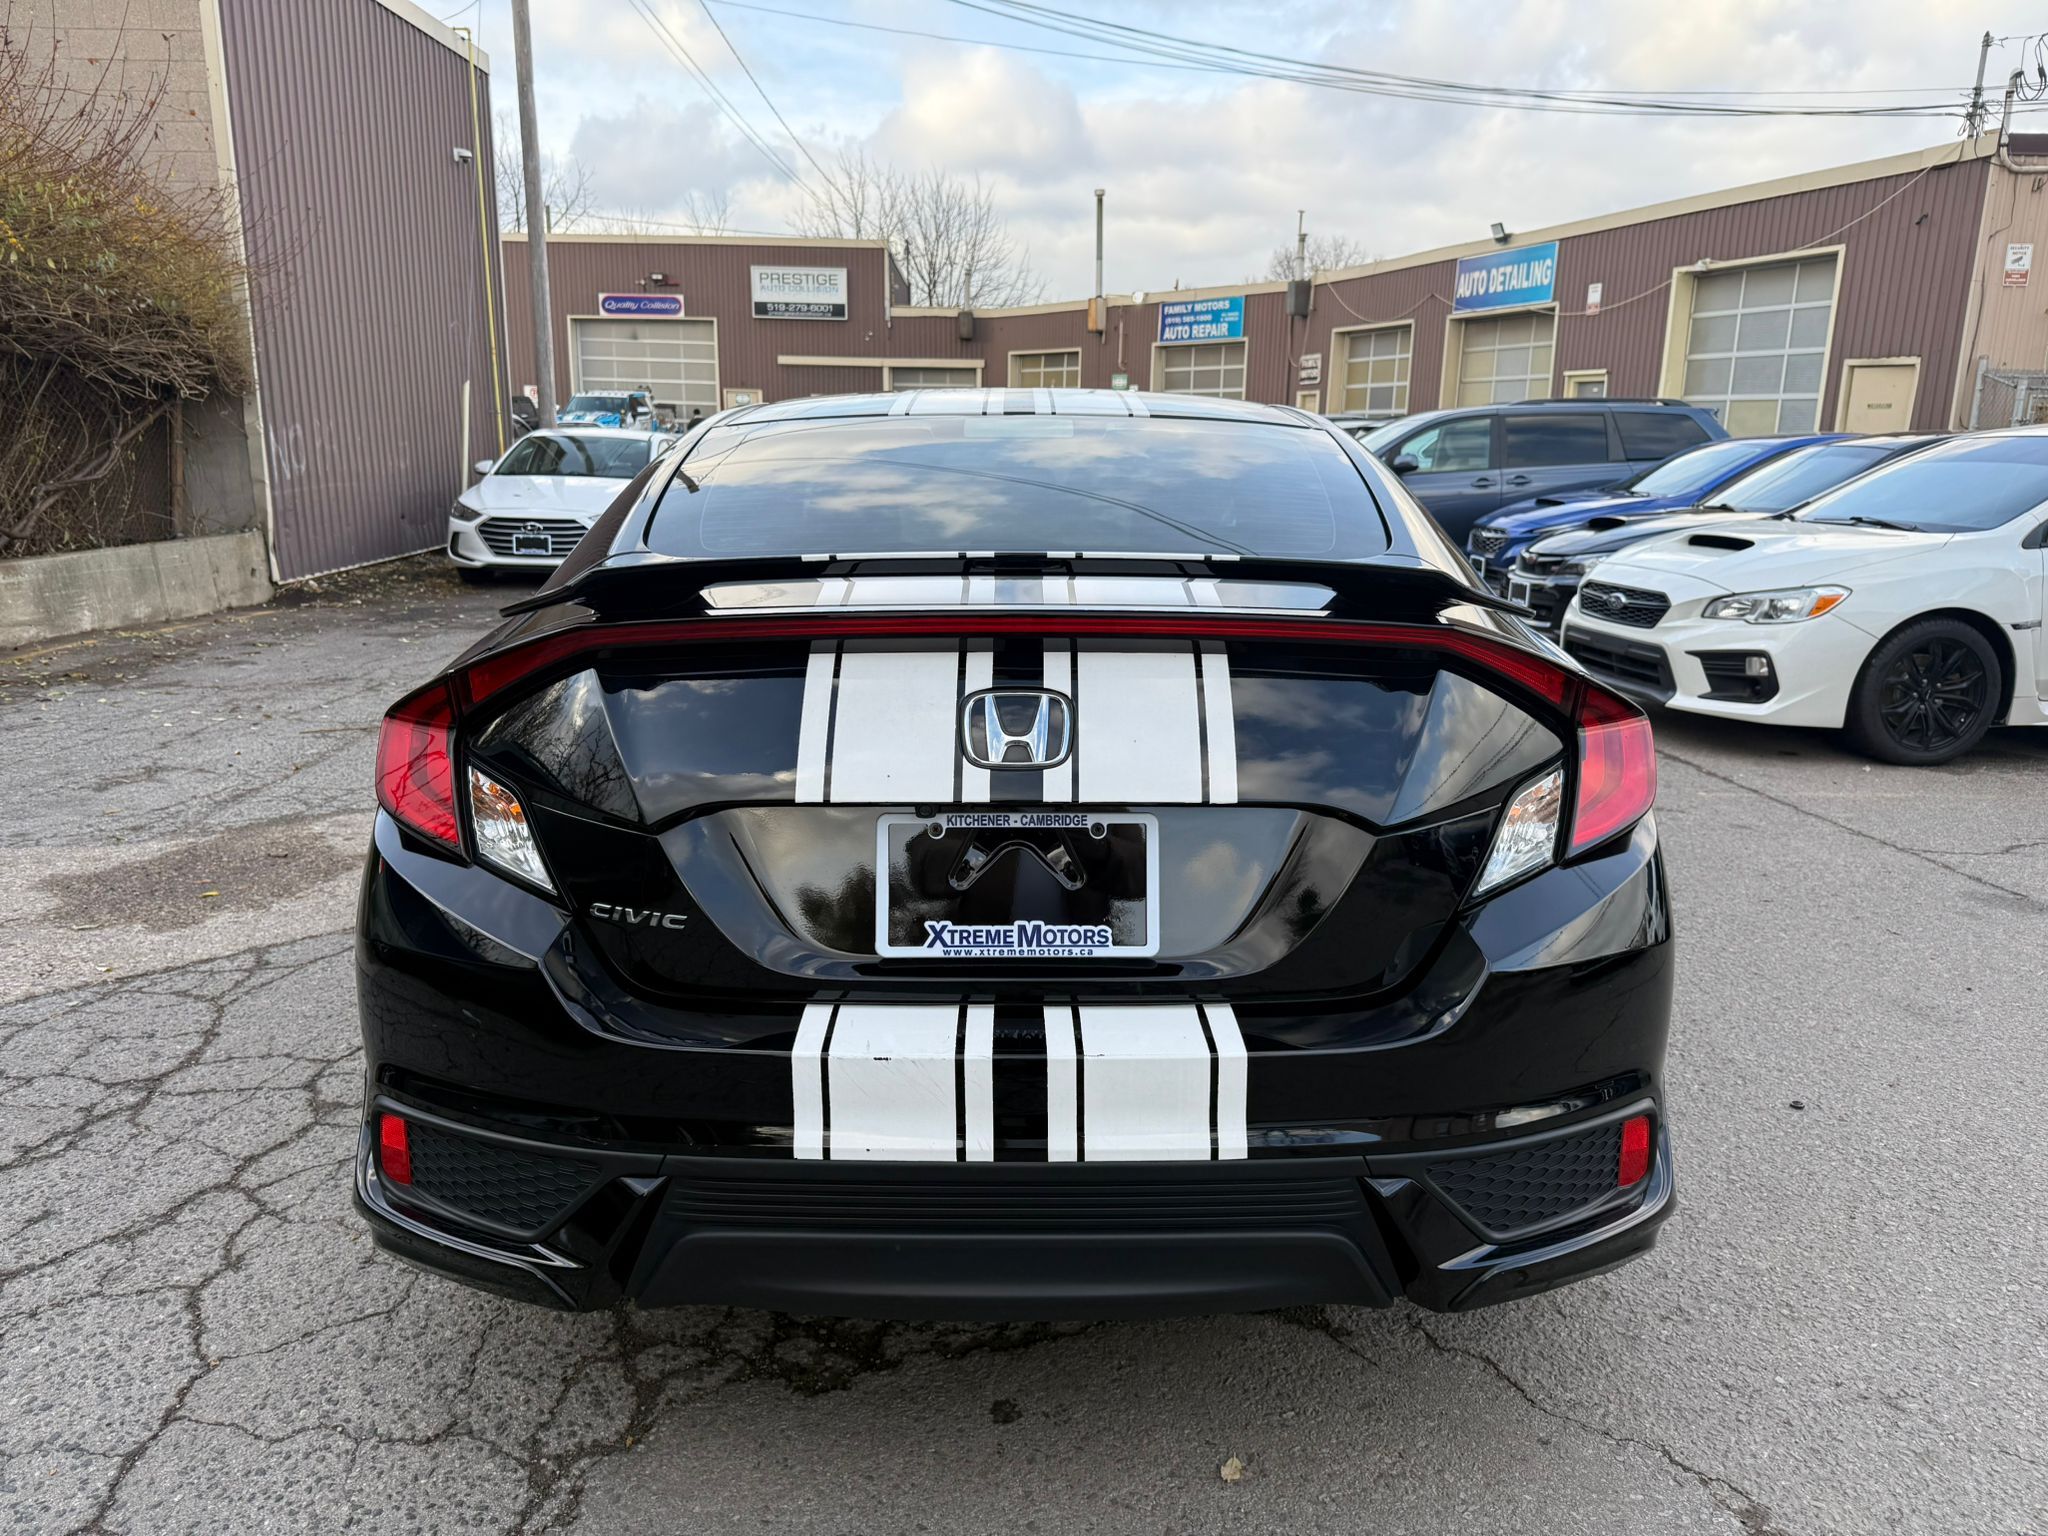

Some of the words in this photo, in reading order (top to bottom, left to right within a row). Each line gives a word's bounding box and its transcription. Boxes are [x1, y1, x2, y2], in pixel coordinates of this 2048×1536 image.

[759, 272, 839, 286] PRESTIGE
[1456, 269, 1488, 299] AUTO
[1488, 258, 1552, 294] DETAILING
[604, 300, 639, 310] Quality
[640, 300, 680, 310] Collision
[766, 303, 833, 312] 519-279-6001
[1164, 303, 1194, 315] FAMILY
[1194, 300, 1230, 312] MOTORS
[1163, 325, 1190, 340] AUTO
[1191, 322, 1229, 338] REPAIR
[946, 815, 1011, 826] KITCHENER
[1020, 815, 1088, 826] CAMBRIDGE
[589, 902, 688, 930] CIVIC
[943, 948, 1094, 956] www.xtrememotors.ca
